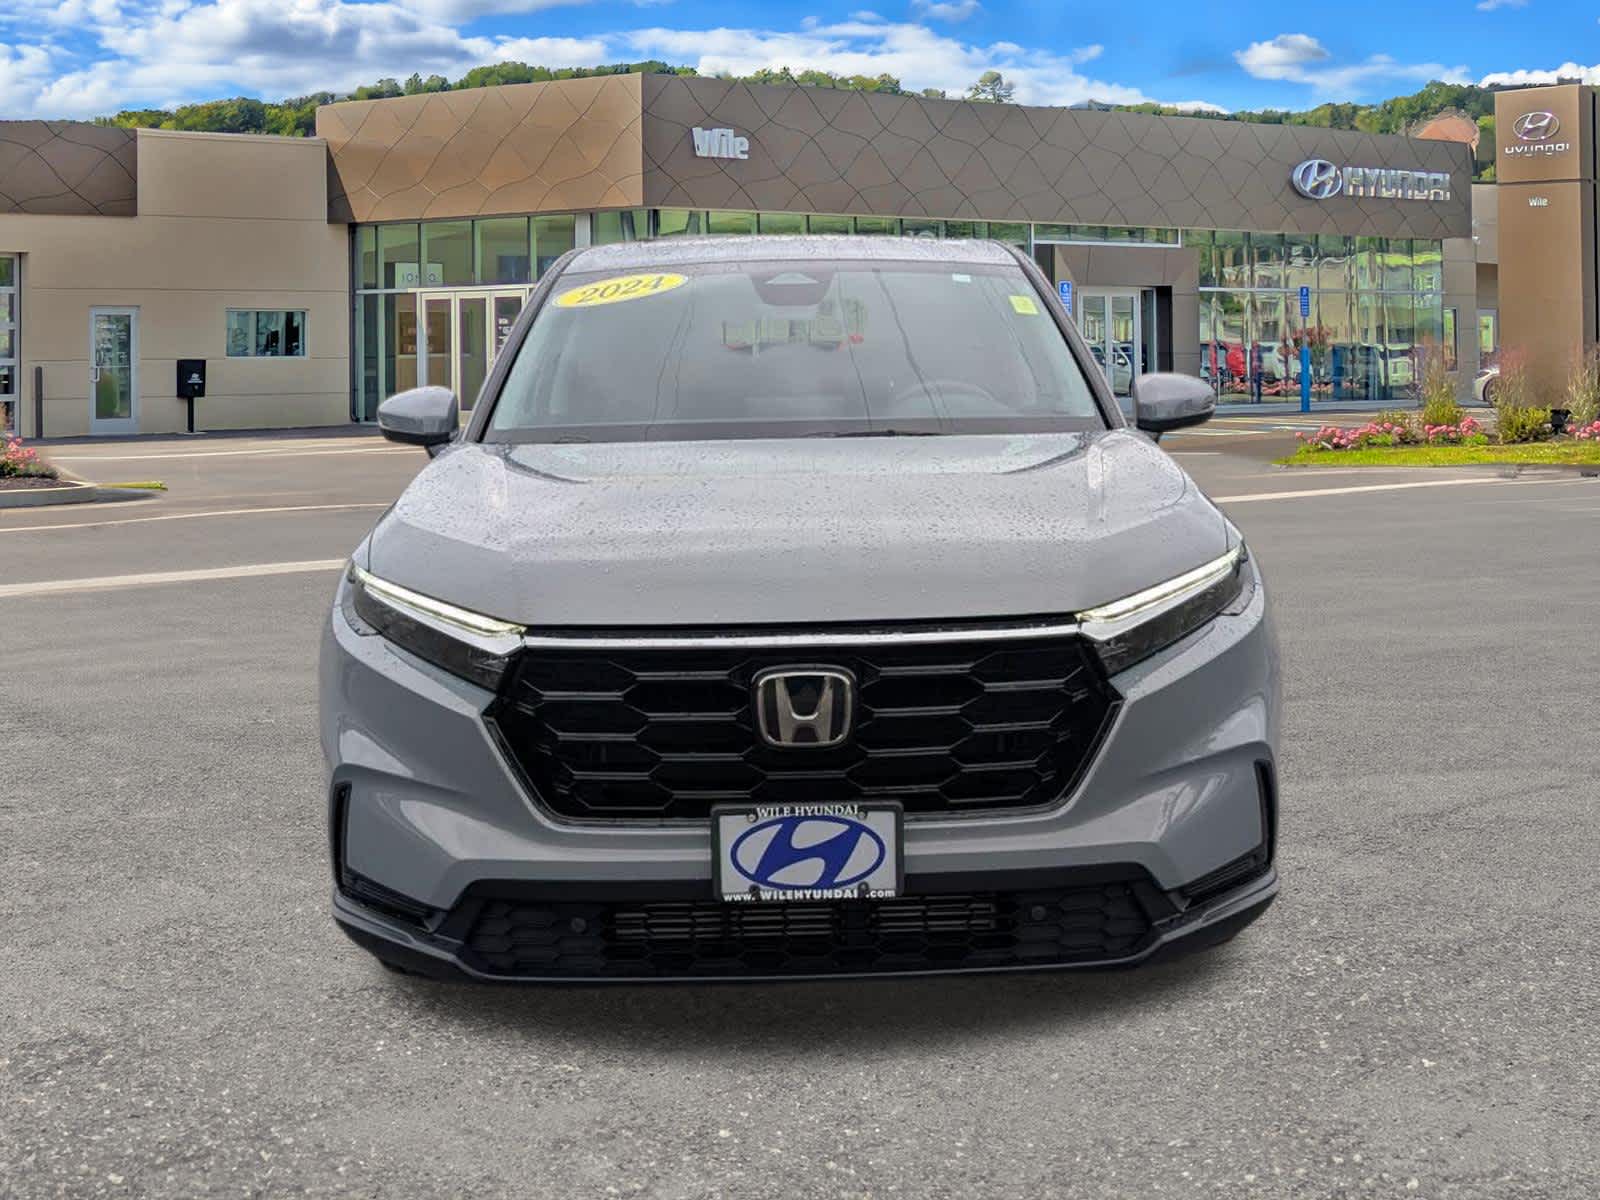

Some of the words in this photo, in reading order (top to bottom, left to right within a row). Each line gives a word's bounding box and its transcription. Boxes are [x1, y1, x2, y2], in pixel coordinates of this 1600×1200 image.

[692, 127, 749, 159] Wile
[1343, 167, 1450, 200] HYUNDAI
[577, 276, 664, 303] 2024
[756, 806, 791, 818] WILE
[795, 804, 858, 817] HYUNDAI
